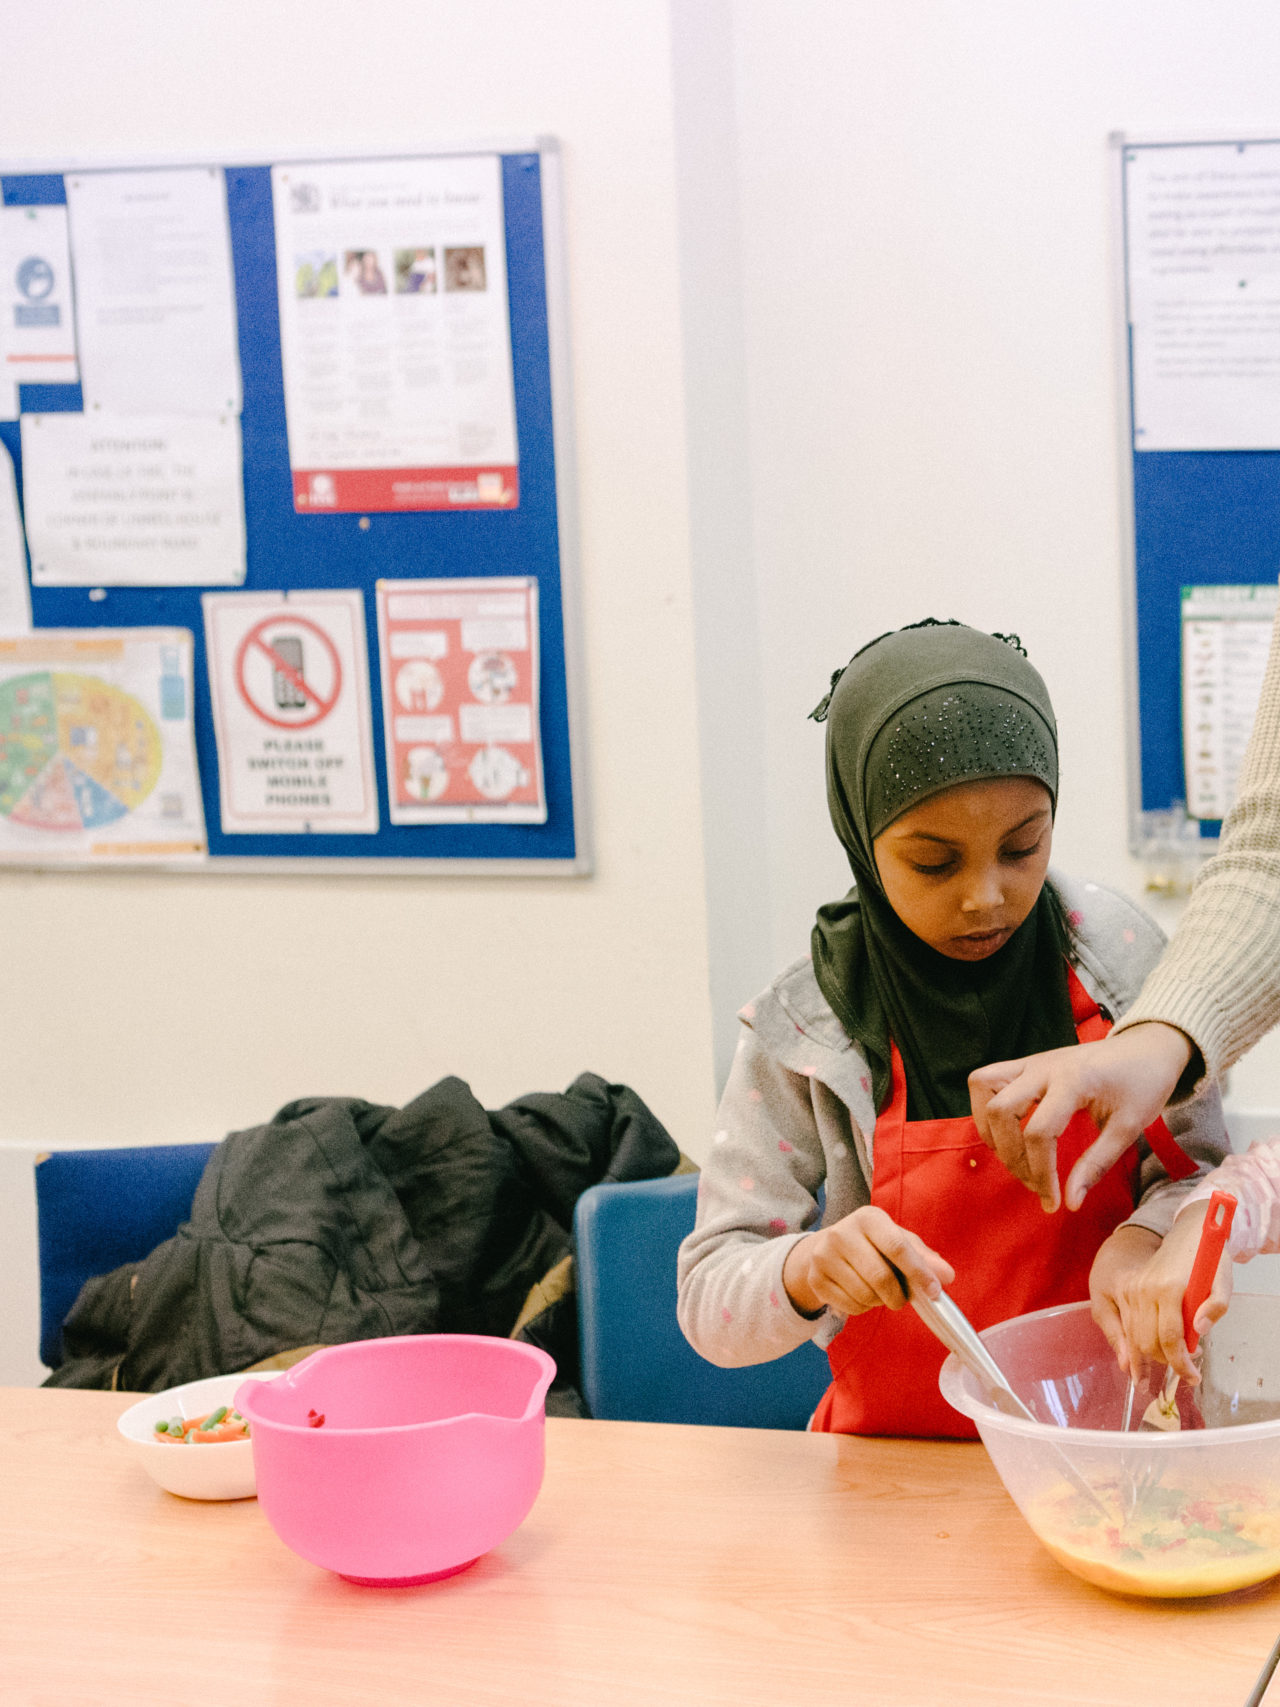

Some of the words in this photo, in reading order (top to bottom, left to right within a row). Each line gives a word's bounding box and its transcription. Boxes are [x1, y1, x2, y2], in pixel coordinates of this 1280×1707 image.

[263, 739, 324, 751] PLEASE
[248, 757, 310, 770] SWITCH
[314, 757, 345, 770] OFF
[267, 776, 327, 788] MOBILE
[265, 794, 332, 806] PHONES
